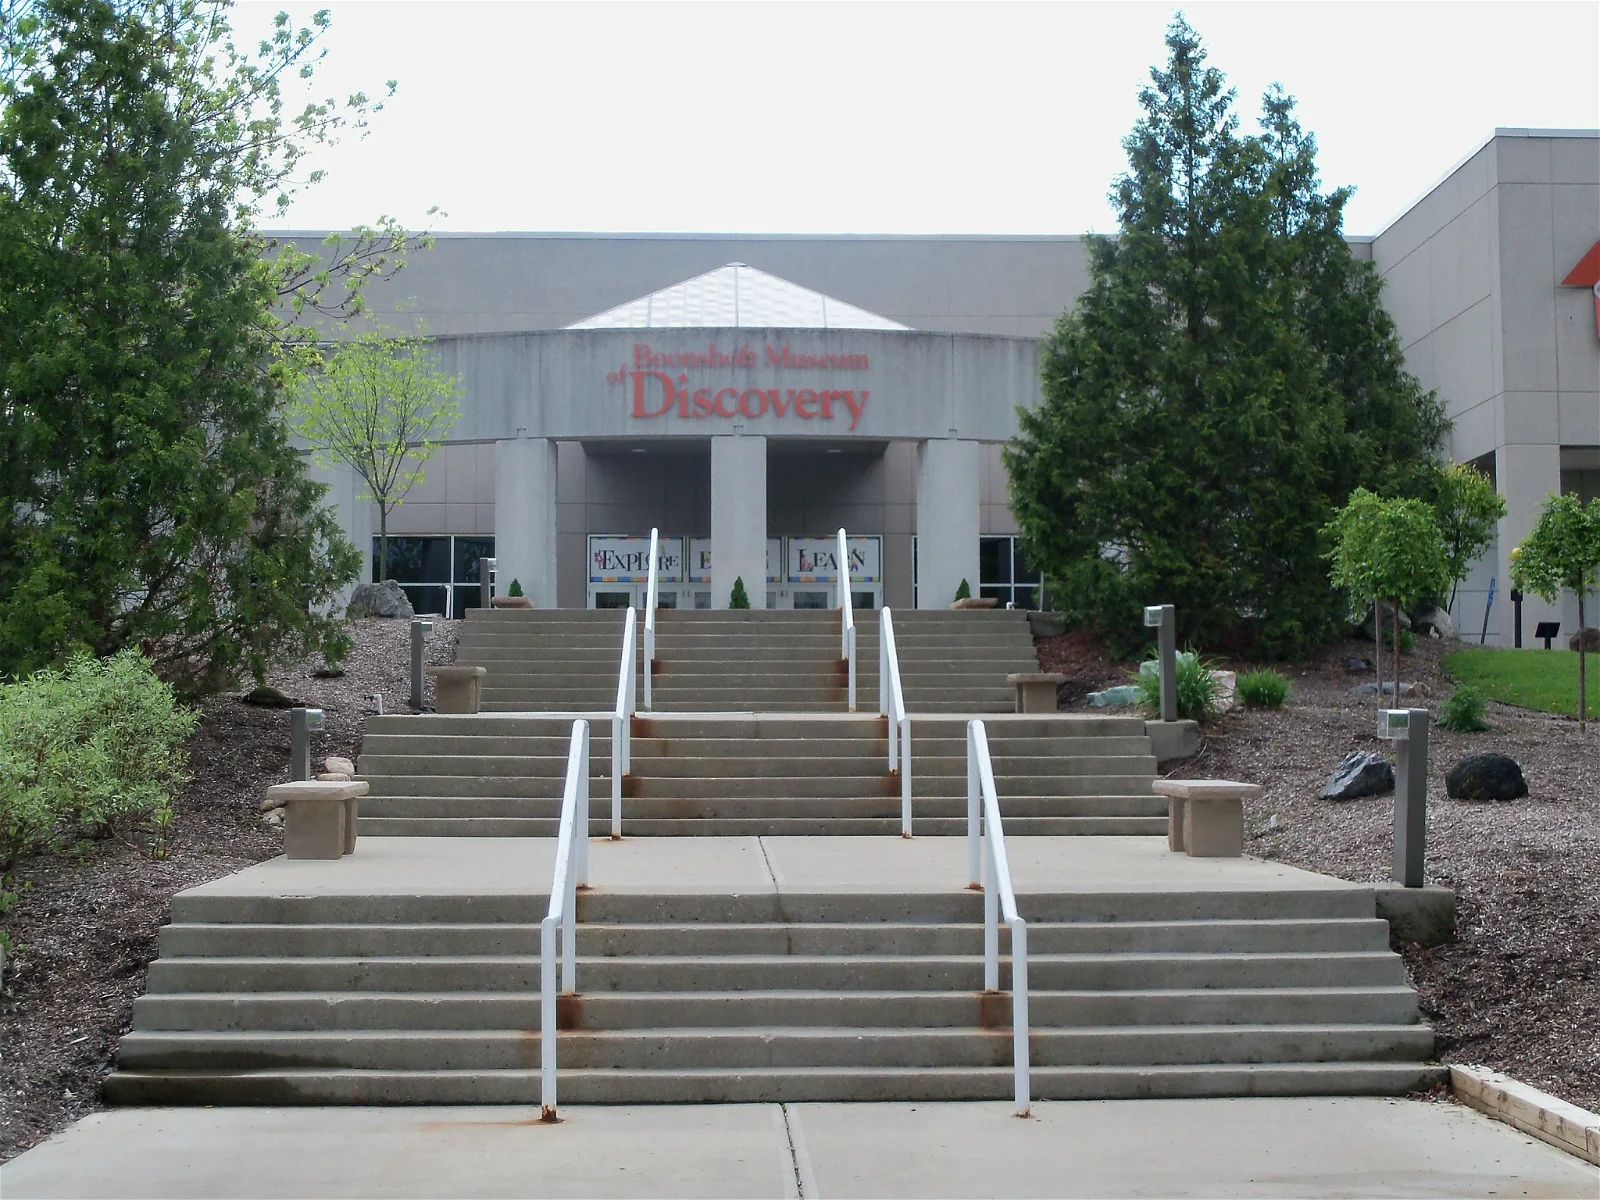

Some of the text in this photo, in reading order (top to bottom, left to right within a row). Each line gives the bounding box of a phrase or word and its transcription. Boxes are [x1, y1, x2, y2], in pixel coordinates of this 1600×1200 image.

[633, 343, 870, 369] Boonshoft Museum
[606, 365, 869, 431] of Discovery
[797, 548, 866, 572] LEAN
